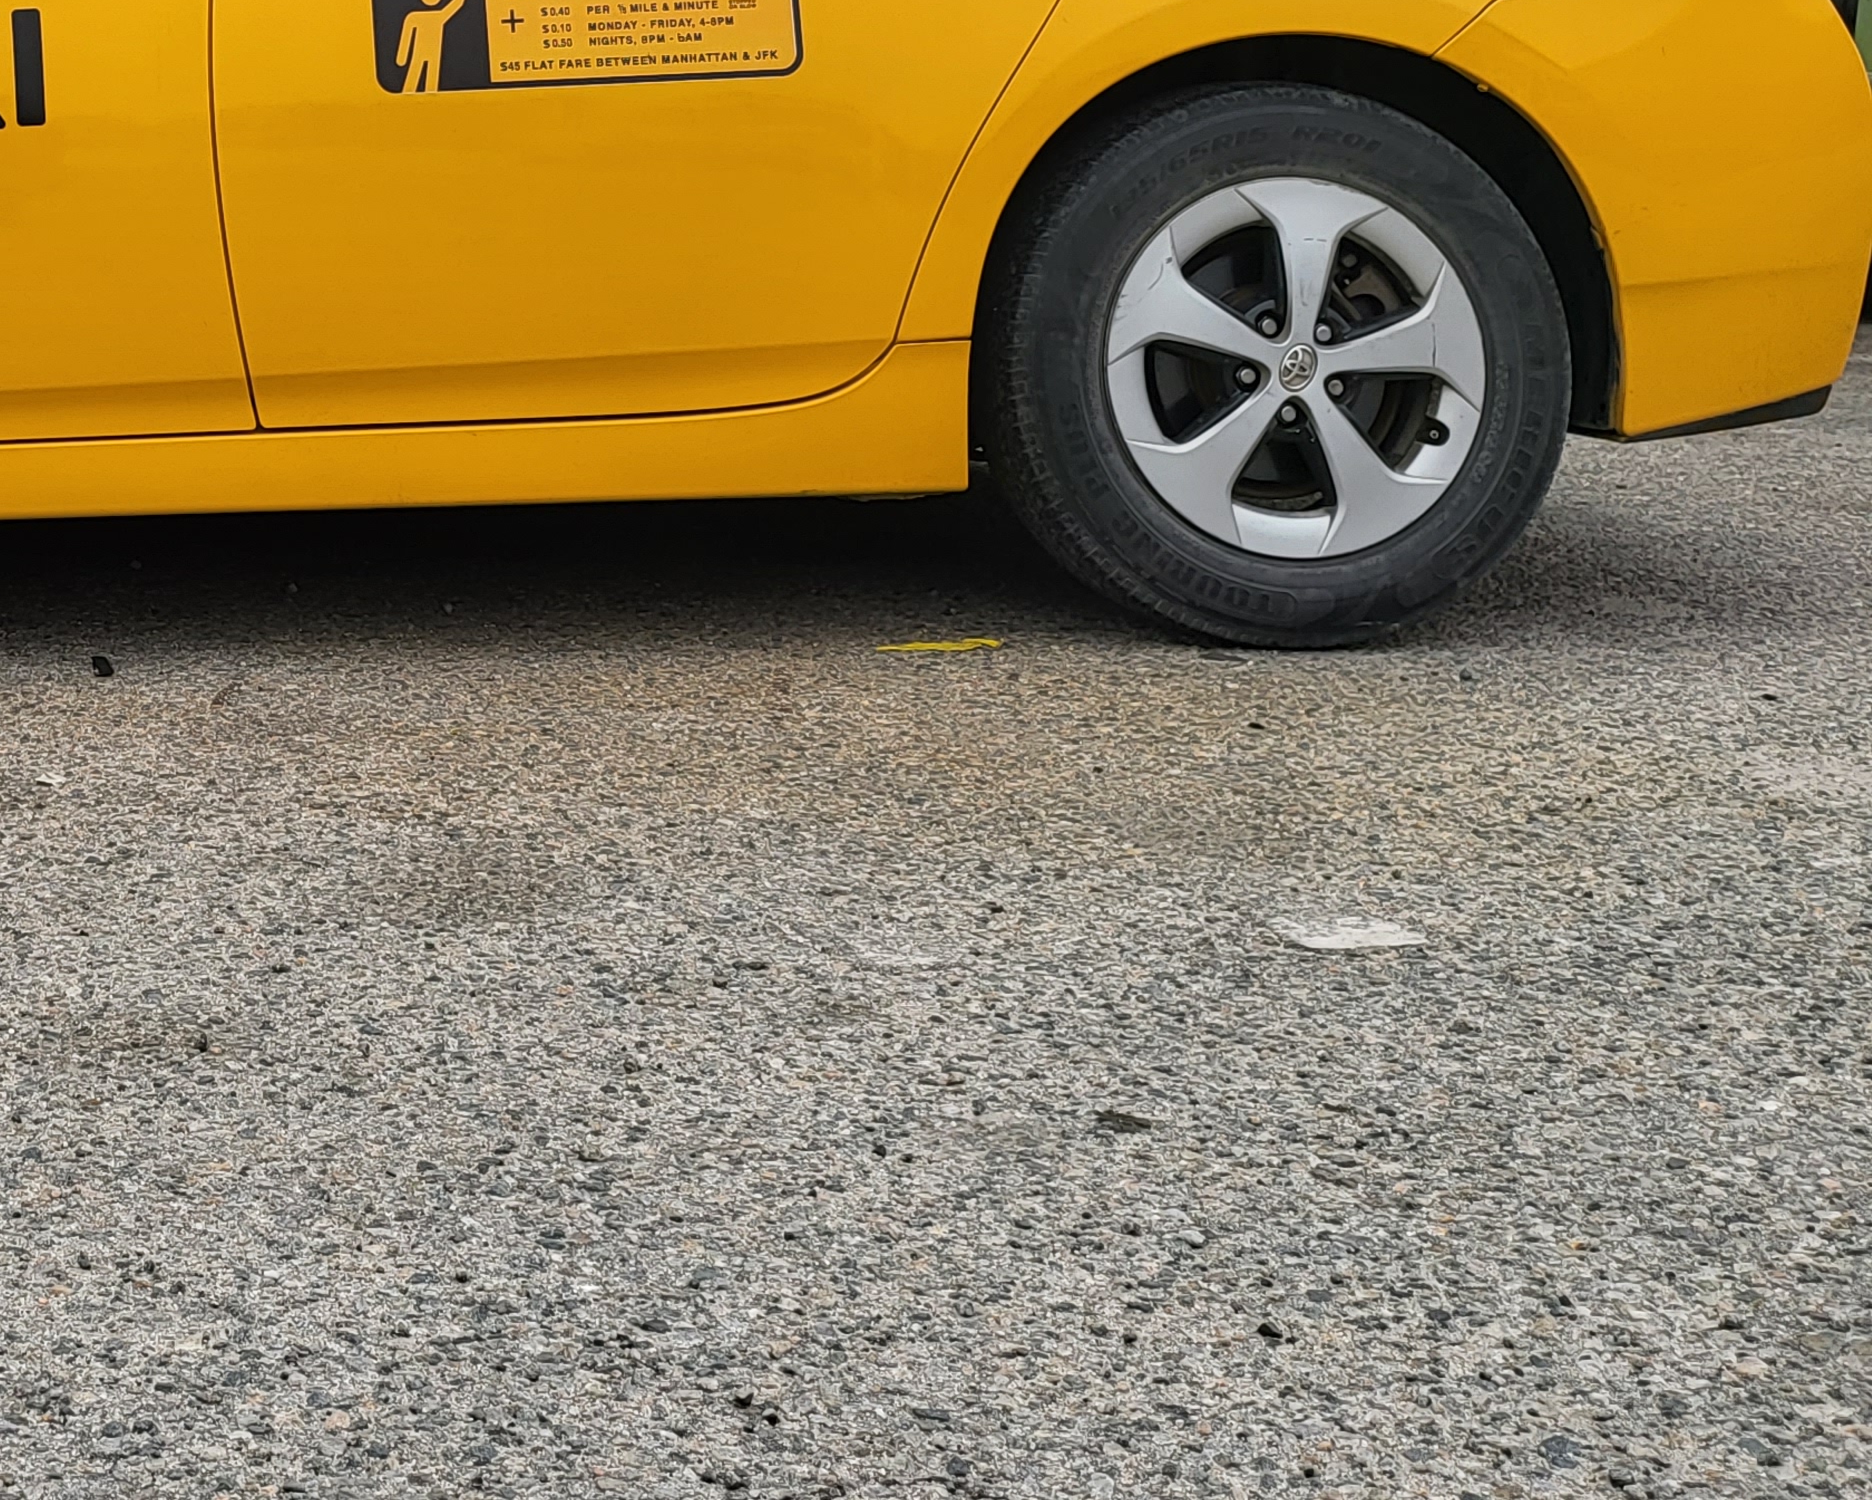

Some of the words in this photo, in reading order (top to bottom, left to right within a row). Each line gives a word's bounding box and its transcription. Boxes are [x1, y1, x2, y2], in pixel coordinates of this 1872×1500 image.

[586, 5, 610, 15] PER
[629, 2, 658, 13] MILE
[673, 0, 720, 11] MINUTE
[587, 20, 638, 32] MONDAY
[649, 18, 695, 30] FRIDAY,
[588, 35, 637, 47] NIGHTS,
[523, 60, 555, 71] FLAT
[558, 58, 592, 69] FARE
[595, 54, 657, 68] BETWEEN
[661, 52, 738, 65] MANHATTAN
[754, 50, 779, 61] JFK
